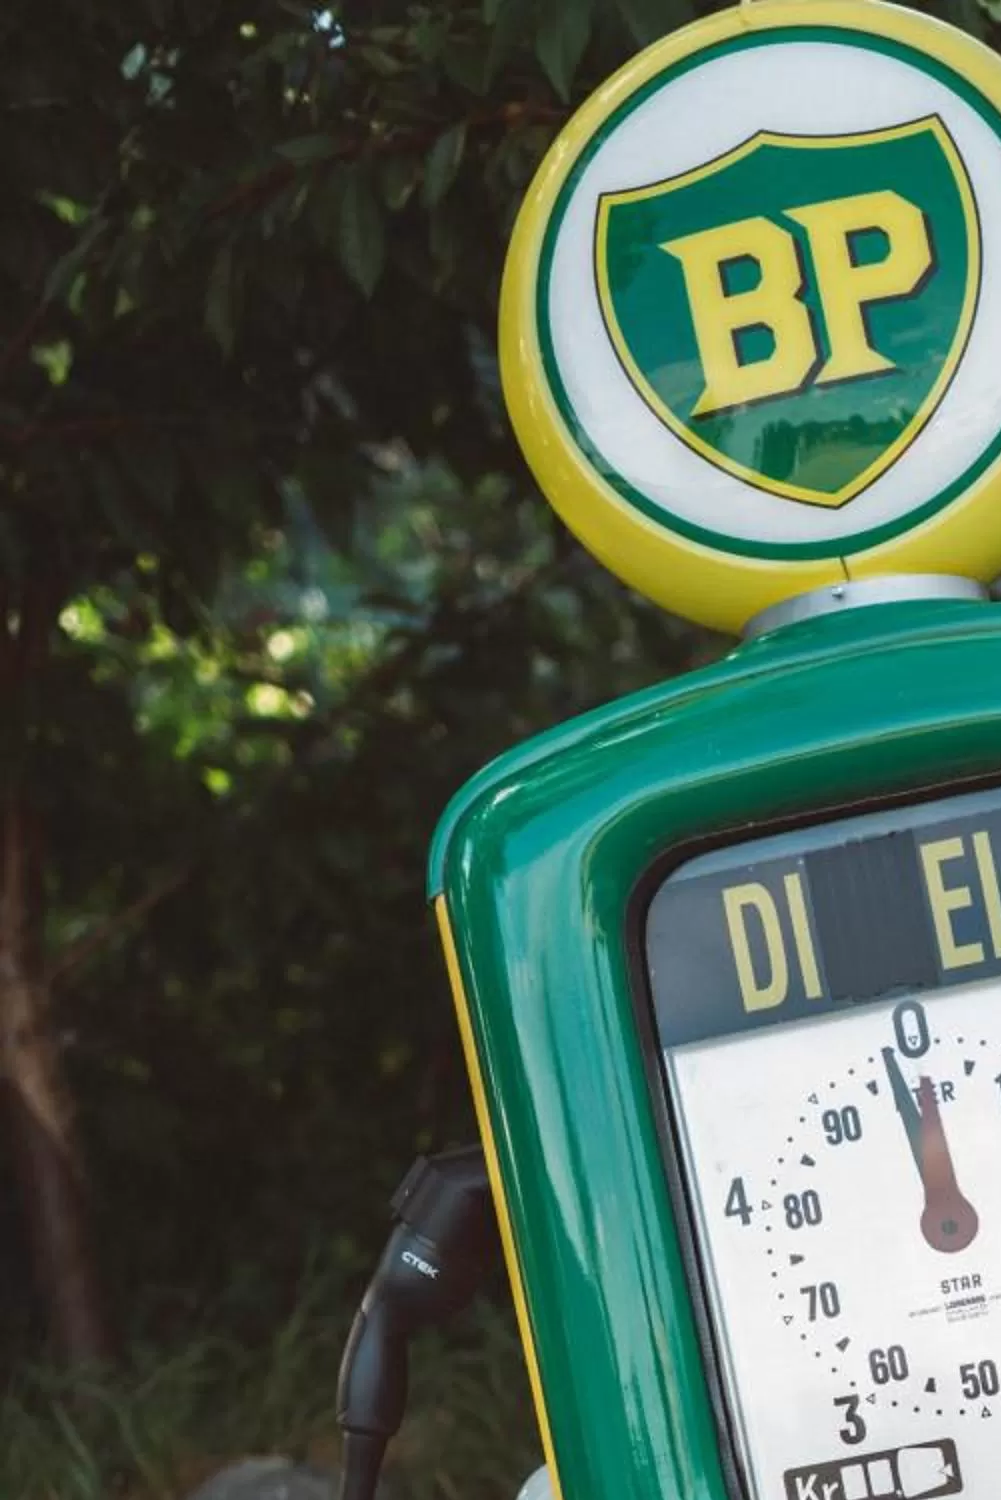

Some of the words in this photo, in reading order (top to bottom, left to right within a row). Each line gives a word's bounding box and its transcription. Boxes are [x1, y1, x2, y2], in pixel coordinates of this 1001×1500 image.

[658, 189, 937, 418] BP
[892, 1000, 931, 1059] 0
[822, 1105, 862, 1146] 90
[724, 1176, 752, 1226] 4
[783, 1188, 823, 1229] 80
[401, 1250, 440, 1279] CTEK
[940, 1273, 982, 1294] STAR
[800, 1281, 840, 1321] 70
[869, 1345, 909, 1385] 60
[960, 1359, 1000, 1400] 50
[833, 1395, 867, 1444] 3
